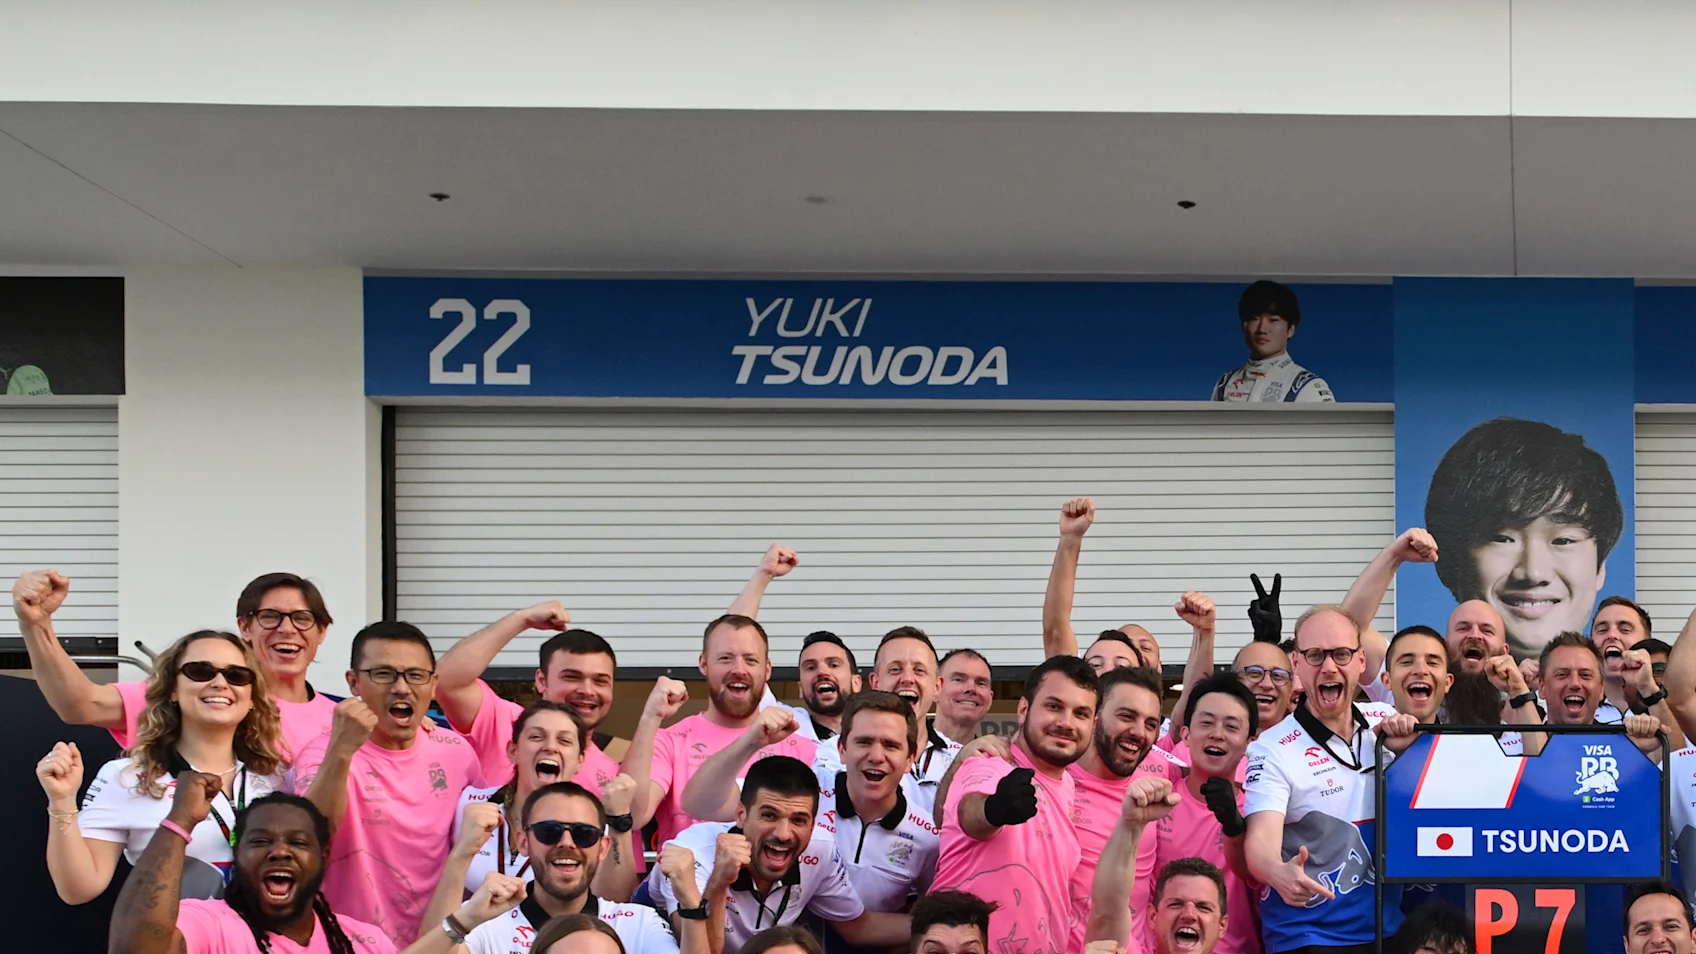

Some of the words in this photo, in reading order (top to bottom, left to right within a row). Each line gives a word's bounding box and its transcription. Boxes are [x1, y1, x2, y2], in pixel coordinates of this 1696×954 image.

[743, 297, 870, 337] YUKI
[428, 297, 531, 386] 22
[731, 345, 1009, 386] TSUNODA
[428, 734, 461, 745] HUGO
[1278, 729, 1302, 746] HUGO
[1583, 745, 1613, 756] VISA
[1308, 757, 1330, 767] ORLEN
[1313, 766, 1337, 776] HONDA
[1320, 785, 1345, 797] TUDOR
[908, 813, 940, 836] HUGO
[1482, 829, 1630, 853] TSUNODA
[799, 856, 819, 865] UGO
